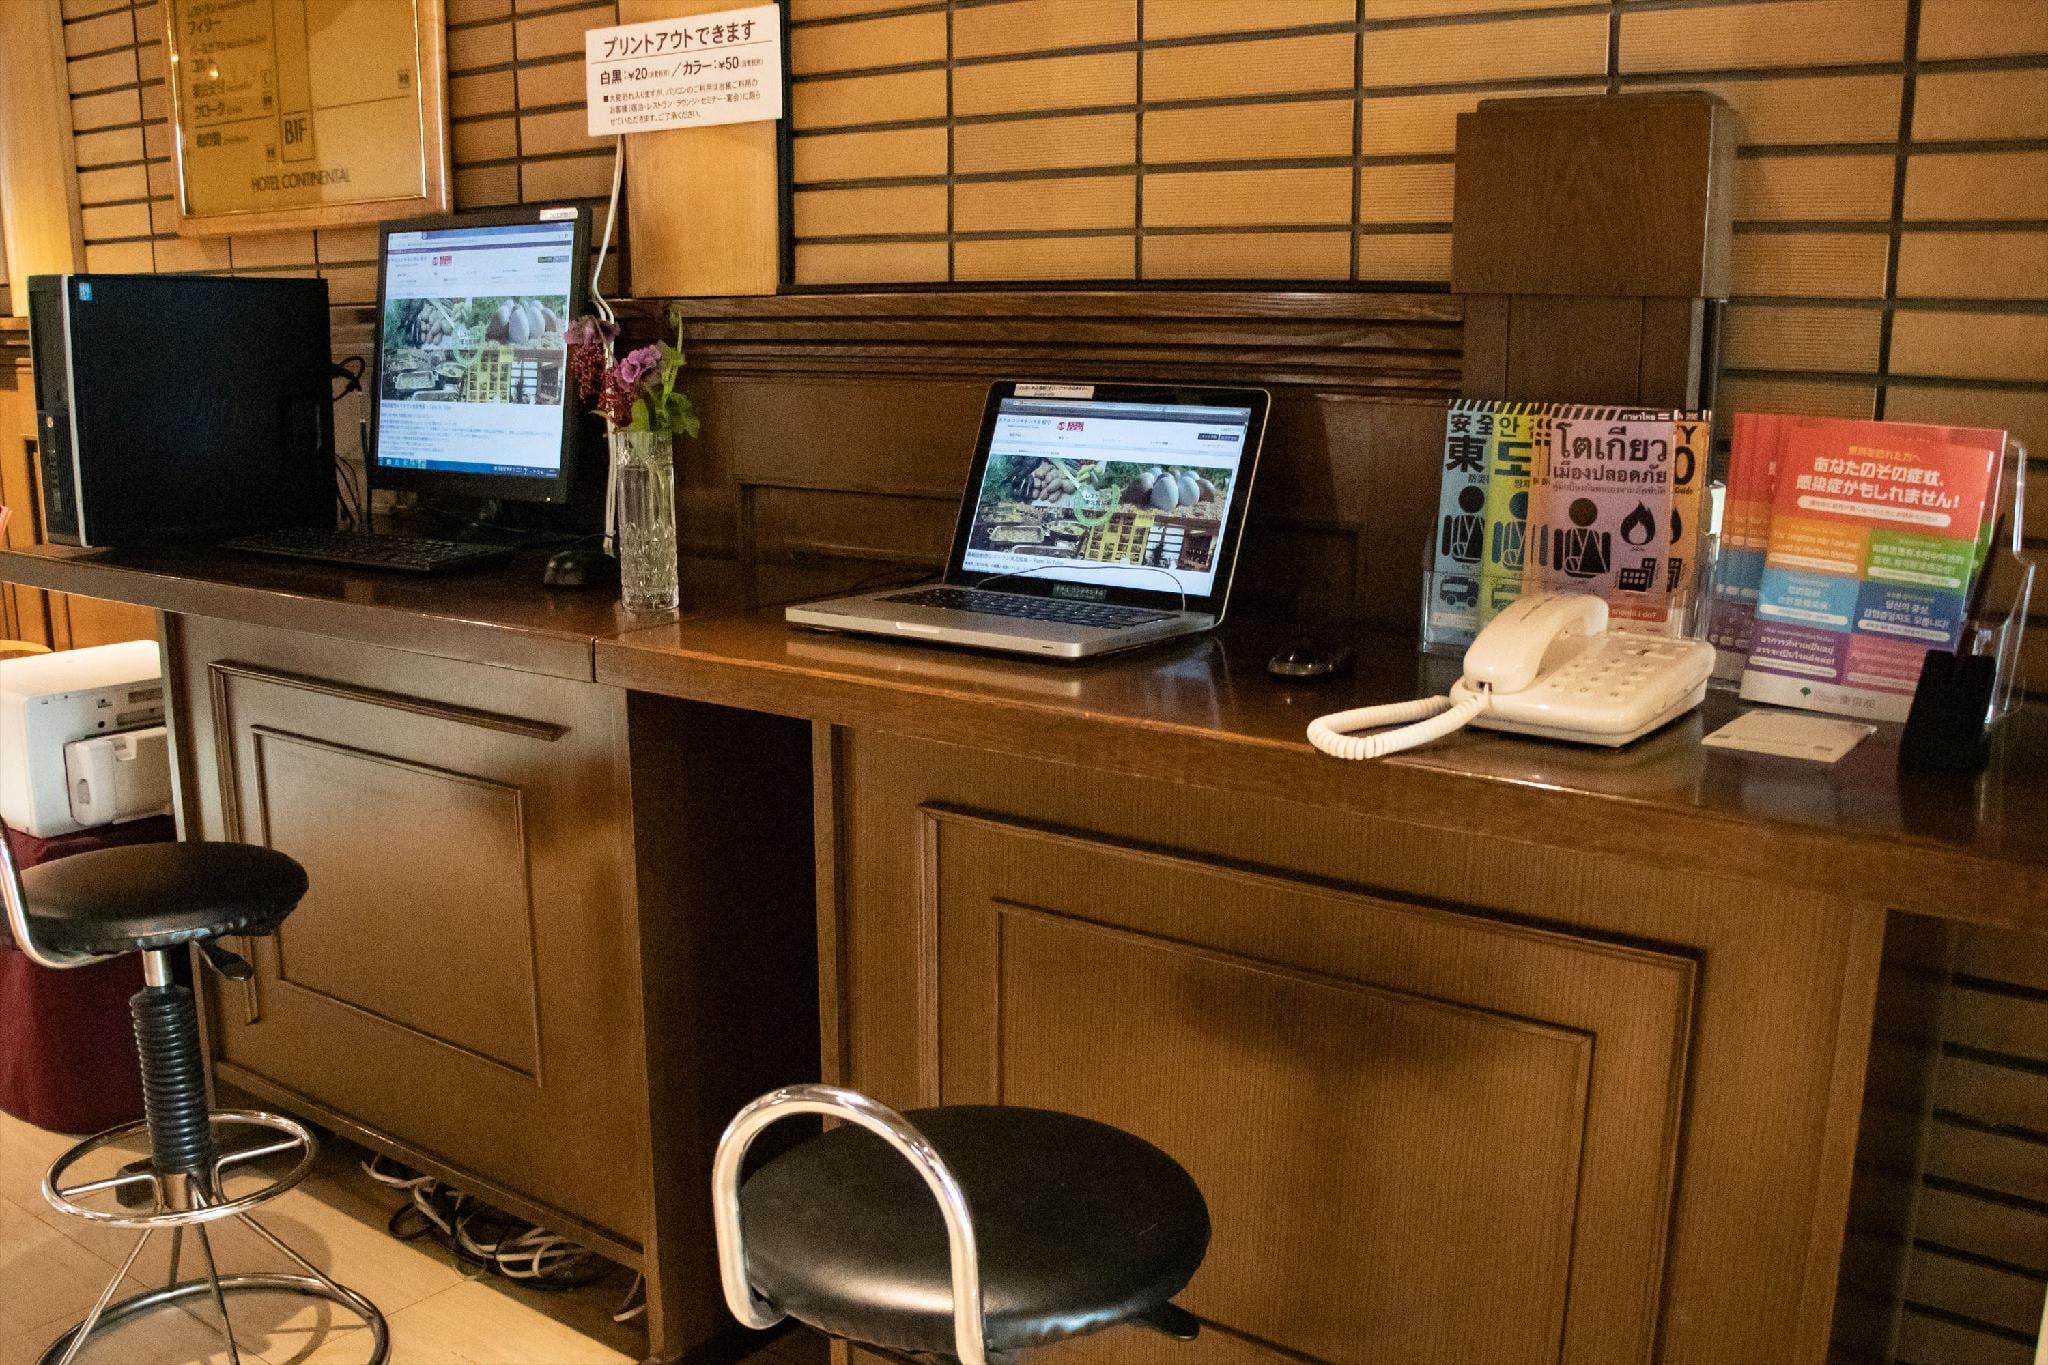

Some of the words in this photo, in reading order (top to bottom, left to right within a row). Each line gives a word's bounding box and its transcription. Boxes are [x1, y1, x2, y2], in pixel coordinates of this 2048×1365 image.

[603, 19, 756, 58] プリントアウトできます
[251, 173, 280, 193] HOTEL
[282, 168, 352, 190] CONTINENTAL
[1446, 434, 1487, 472] 東
[1555, 421, 1668, 463] โตเกียว
[1553, 460, 1668, 485] เมืองปลอดภัย
[1813, 456, 1944, 487] あなたのその症状、
[1796, 474, 1960, 509] 感染症かもしれません!
